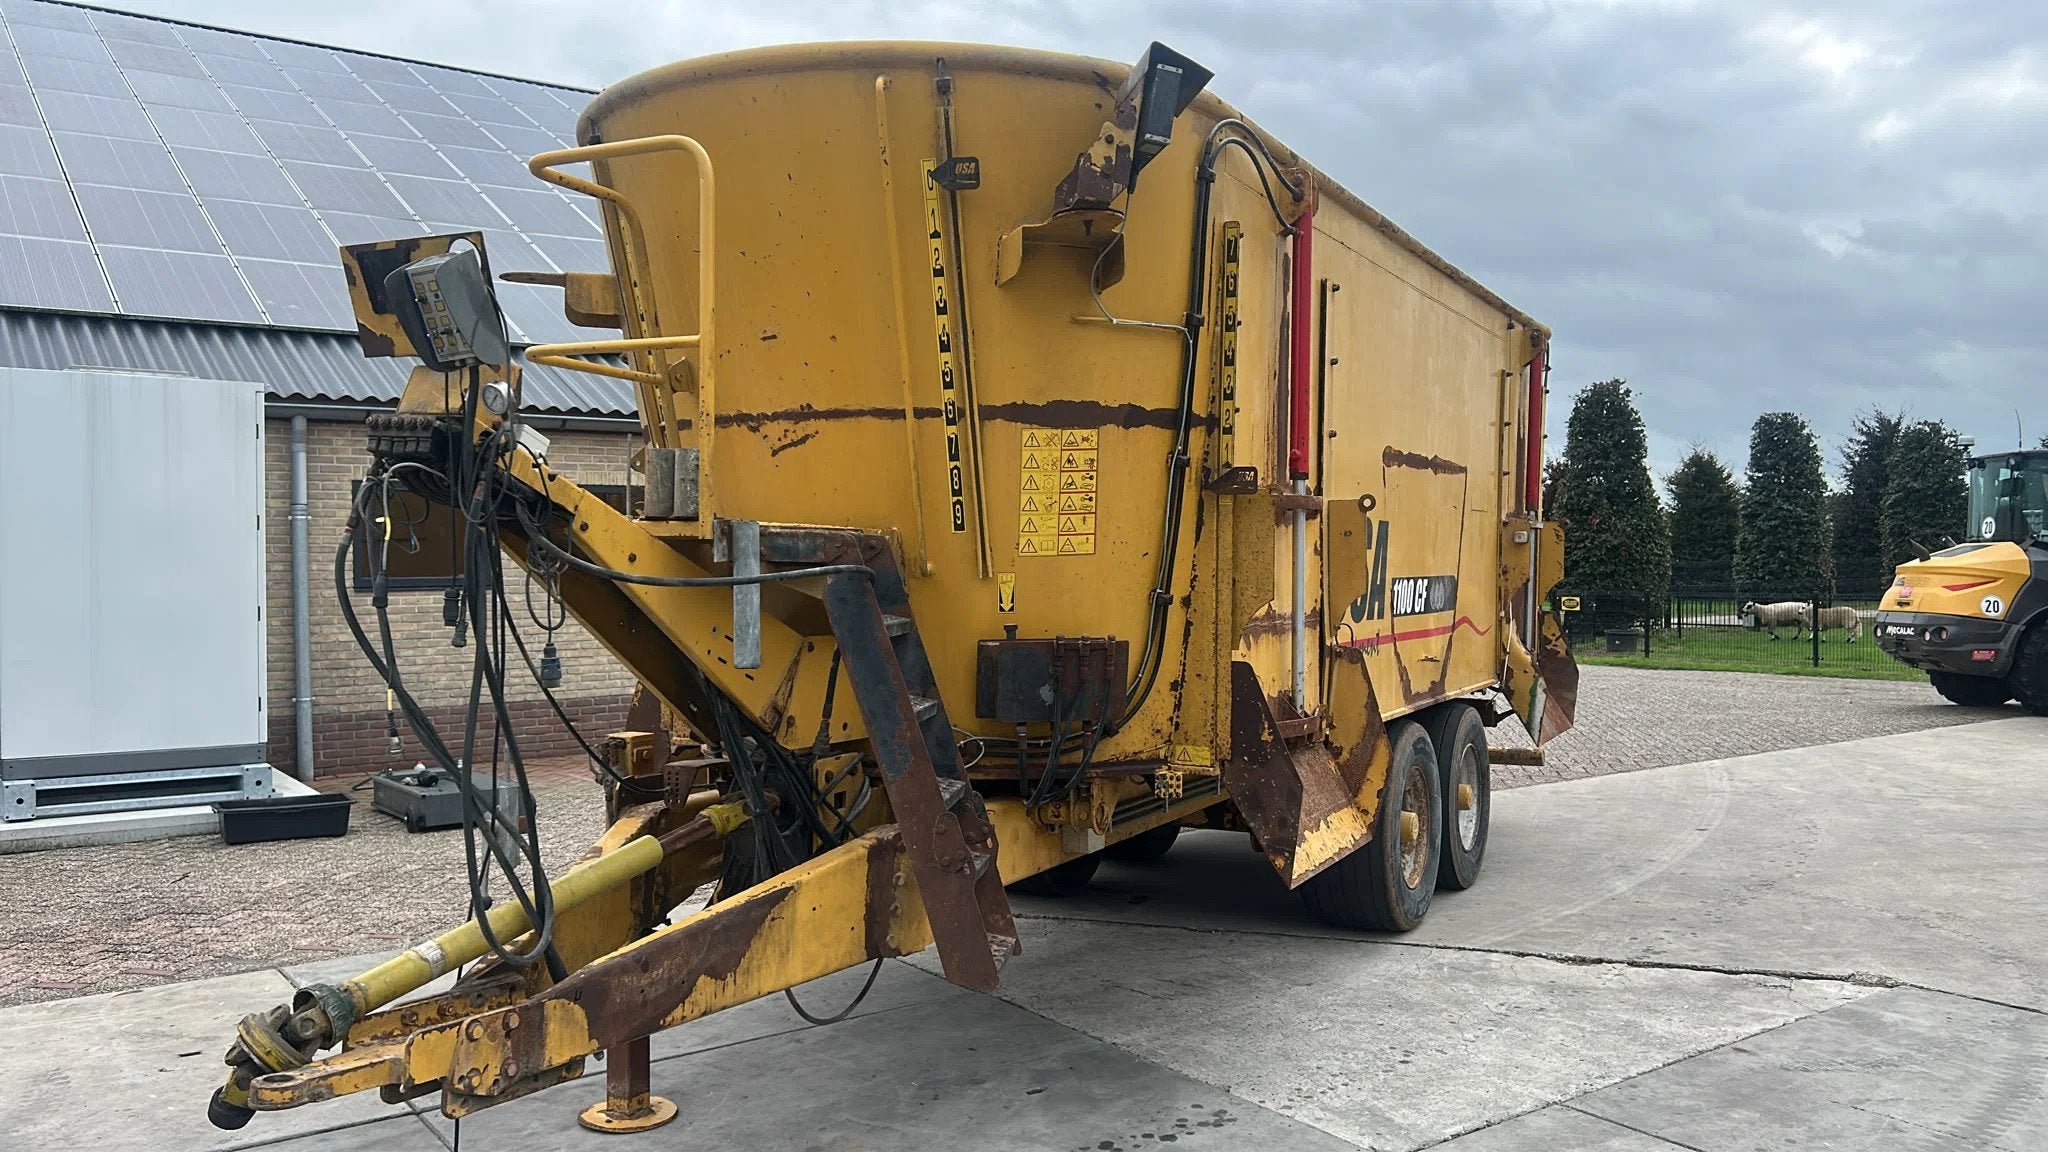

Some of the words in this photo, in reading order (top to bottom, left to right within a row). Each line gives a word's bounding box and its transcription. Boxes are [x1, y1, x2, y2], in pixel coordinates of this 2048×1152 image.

[933, 247, 941, 270] 2
[938, 286, 945, 308] 3
[941, 324, 949, 345] 4
[944, 361, 951, 382] 5
[947, 398, 954, 418] 6
[1224, 408, 1231, 428] 2
[949, 433, 957, 455] 7
[952, 469, 960, 490] 8
[955, 504, 962, 525] 9
[1984, 521, 1993, 535] 20
[1393, 578, 1415, 615] 1100
[1414, 578, 1429, 613] CF
[1985, 599, 2000, 613] 20
